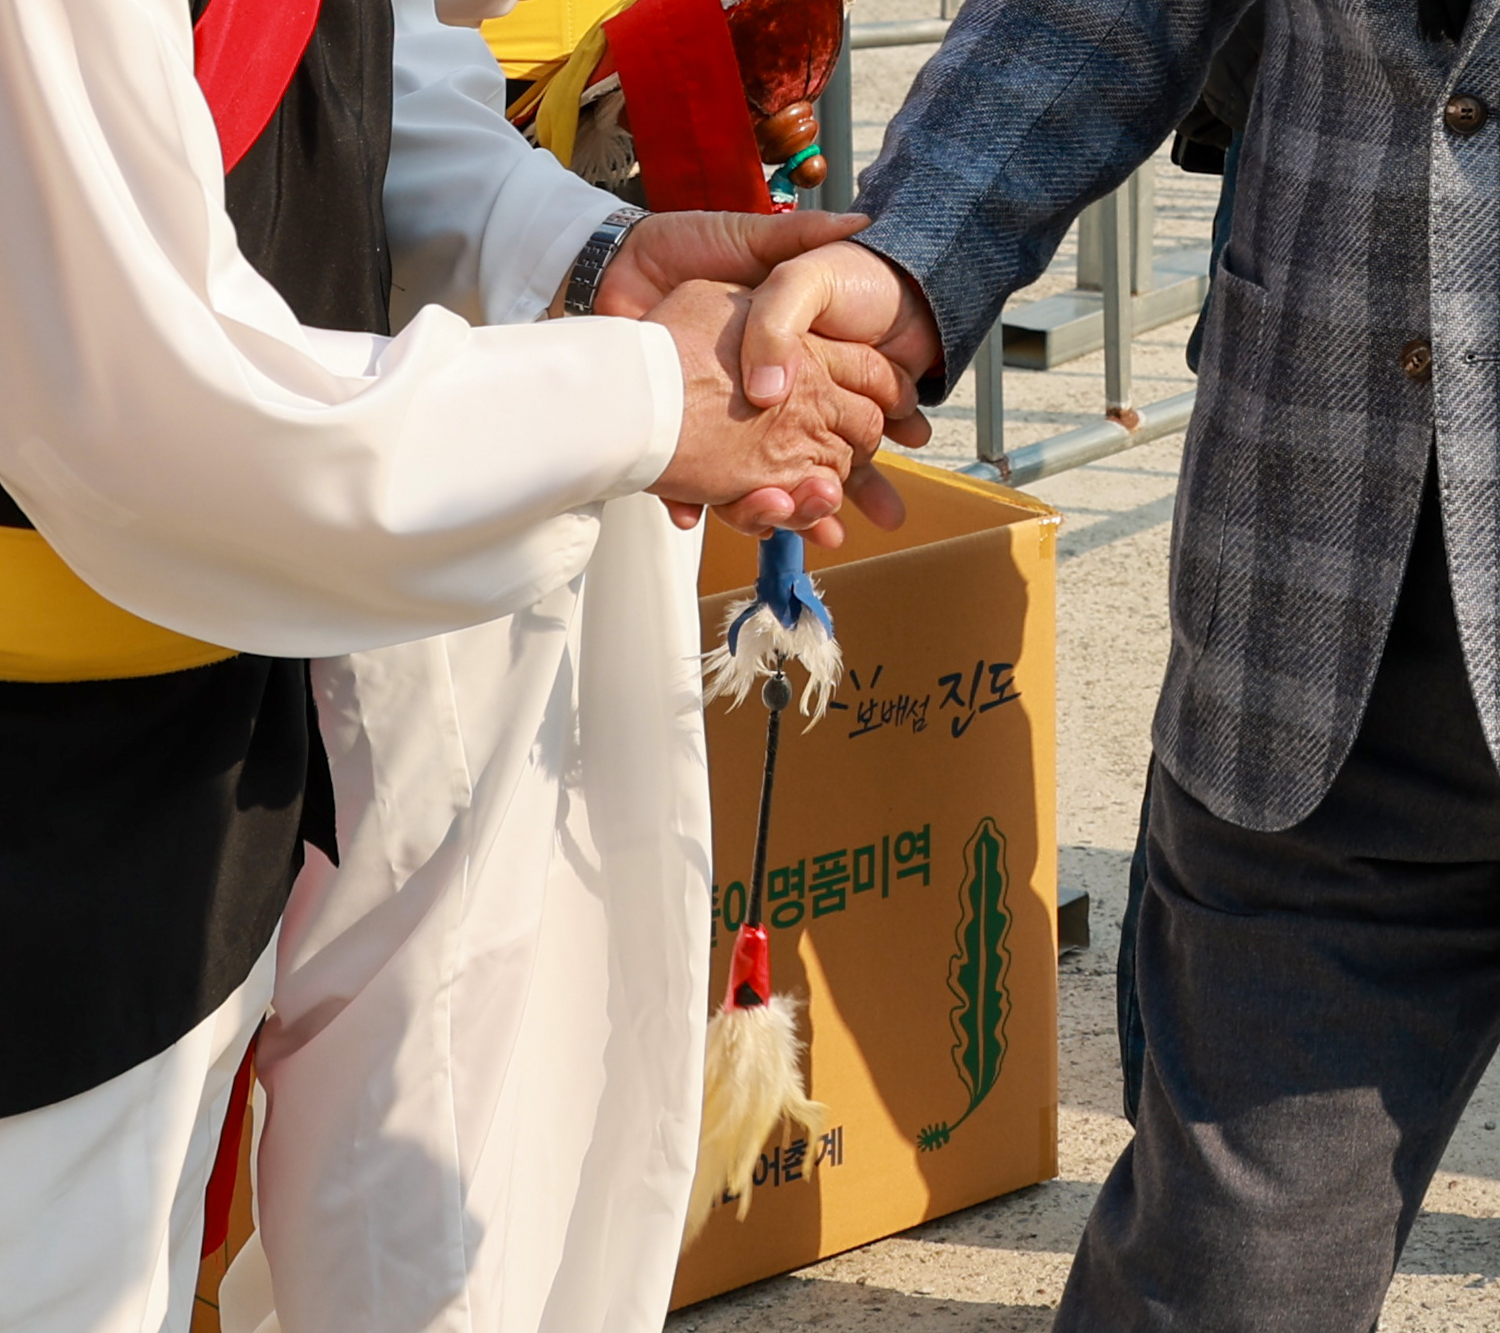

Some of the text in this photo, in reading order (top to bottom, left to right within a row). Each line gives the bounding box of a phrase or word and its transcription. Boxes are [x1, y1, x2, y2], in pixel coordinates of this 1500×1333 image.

[849, 659, 1022, 739] 보배섬 진도
[767, 823, 931, 929] 명품미역
